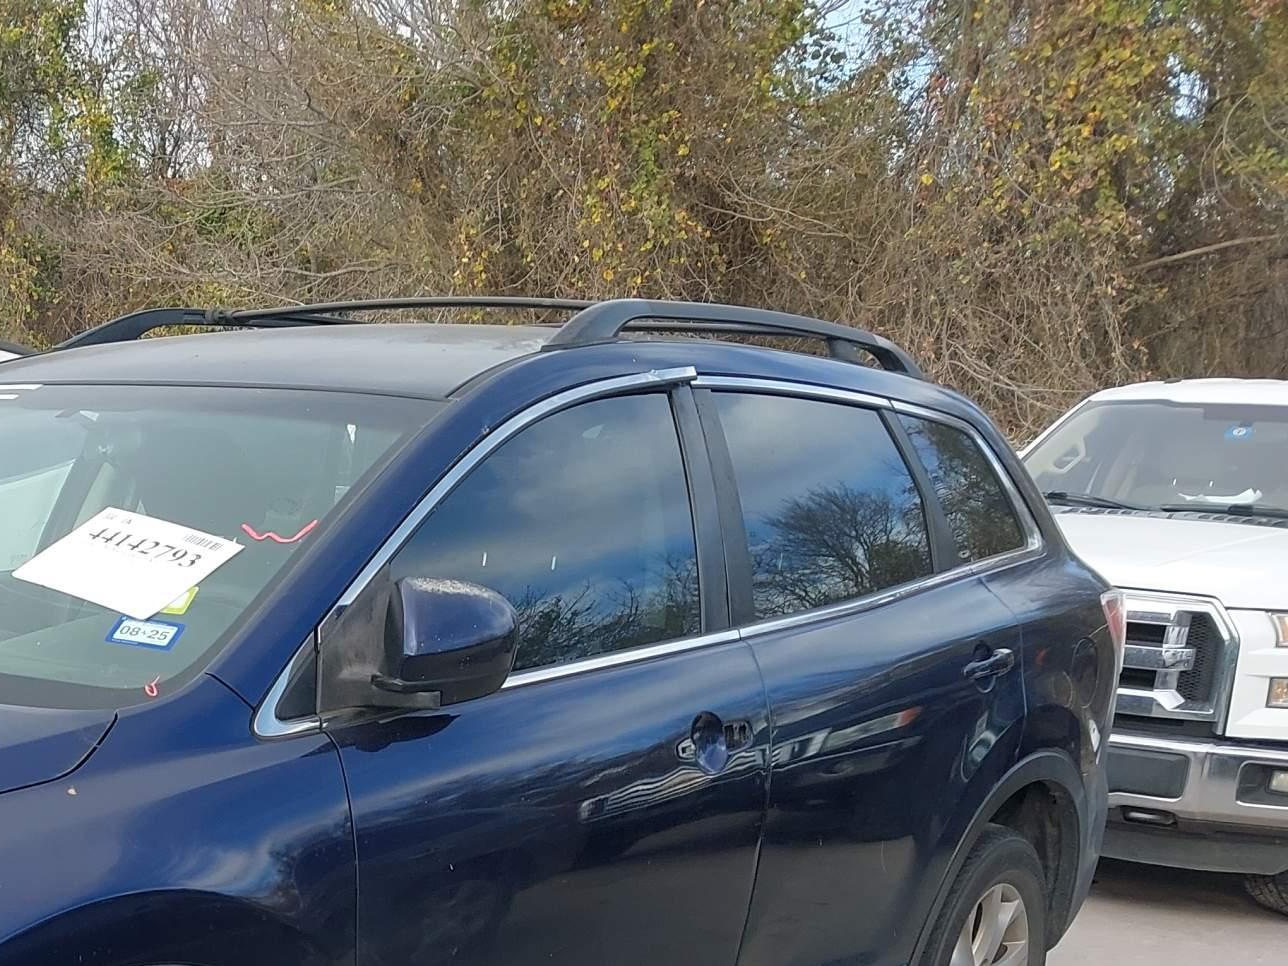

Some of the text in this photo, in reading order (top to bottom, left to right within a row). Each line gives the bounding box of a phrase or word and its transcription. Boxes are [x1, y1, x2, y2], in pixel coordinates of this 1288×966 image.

[89, 528, 202, 567] 44142793
[119, 625, 170, 641] 08 25
